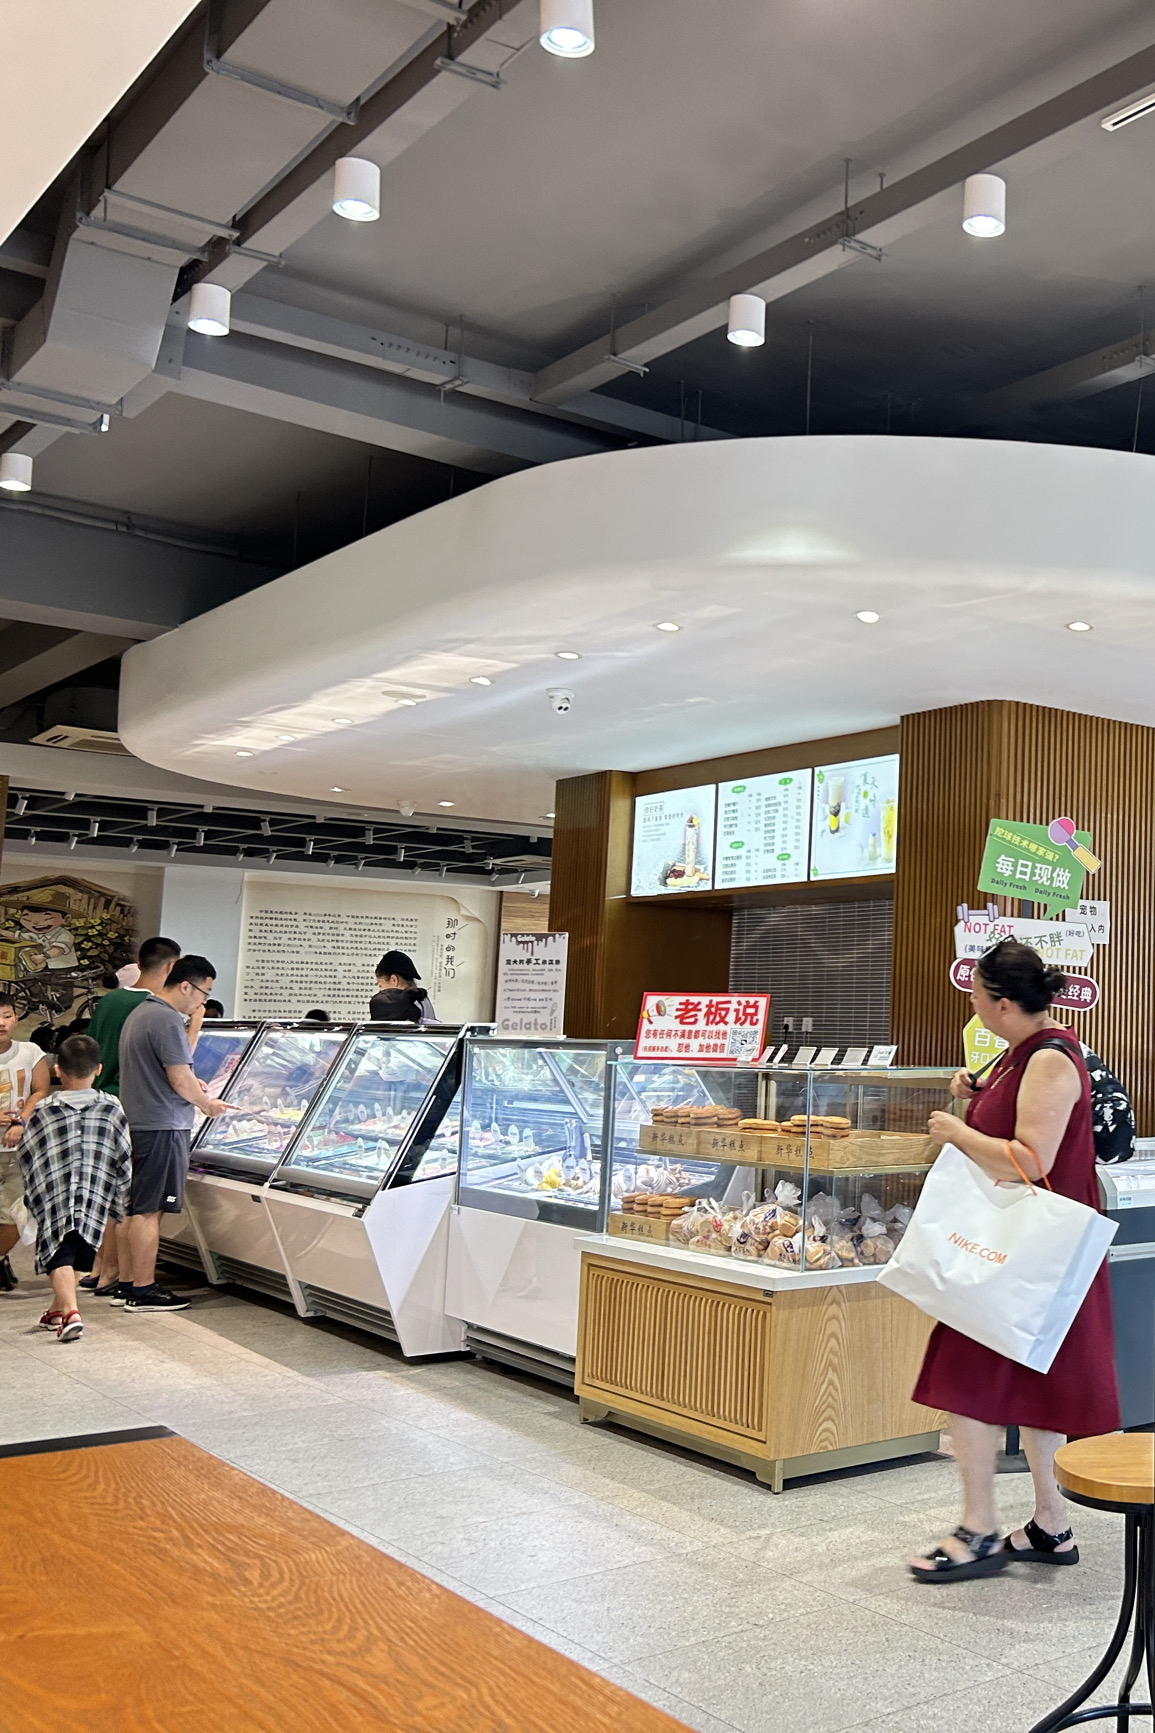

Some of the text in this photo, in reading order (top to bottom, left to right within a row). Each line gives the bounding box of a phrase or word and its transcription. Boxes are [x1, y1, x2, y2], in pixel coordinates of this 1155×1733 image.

[995, 854, 1072, 890] 每日现做
[991, 878, 1070, 901] Daily Fresh Daily Fresh
[963, 922, 1014, 935] NOT FAT
[443, 917, 459, 980] 那时的我们
[1036, 946, 1086, 960] NOT FAT
[501, 1017, 548, 1031] Gelato
[674, 999, 760, 1027] 老板说
[644, 1029, 728, 1040] 您有任何不满意都可以找他
[947, 1231, 1009, 1265] NIKE.COM
